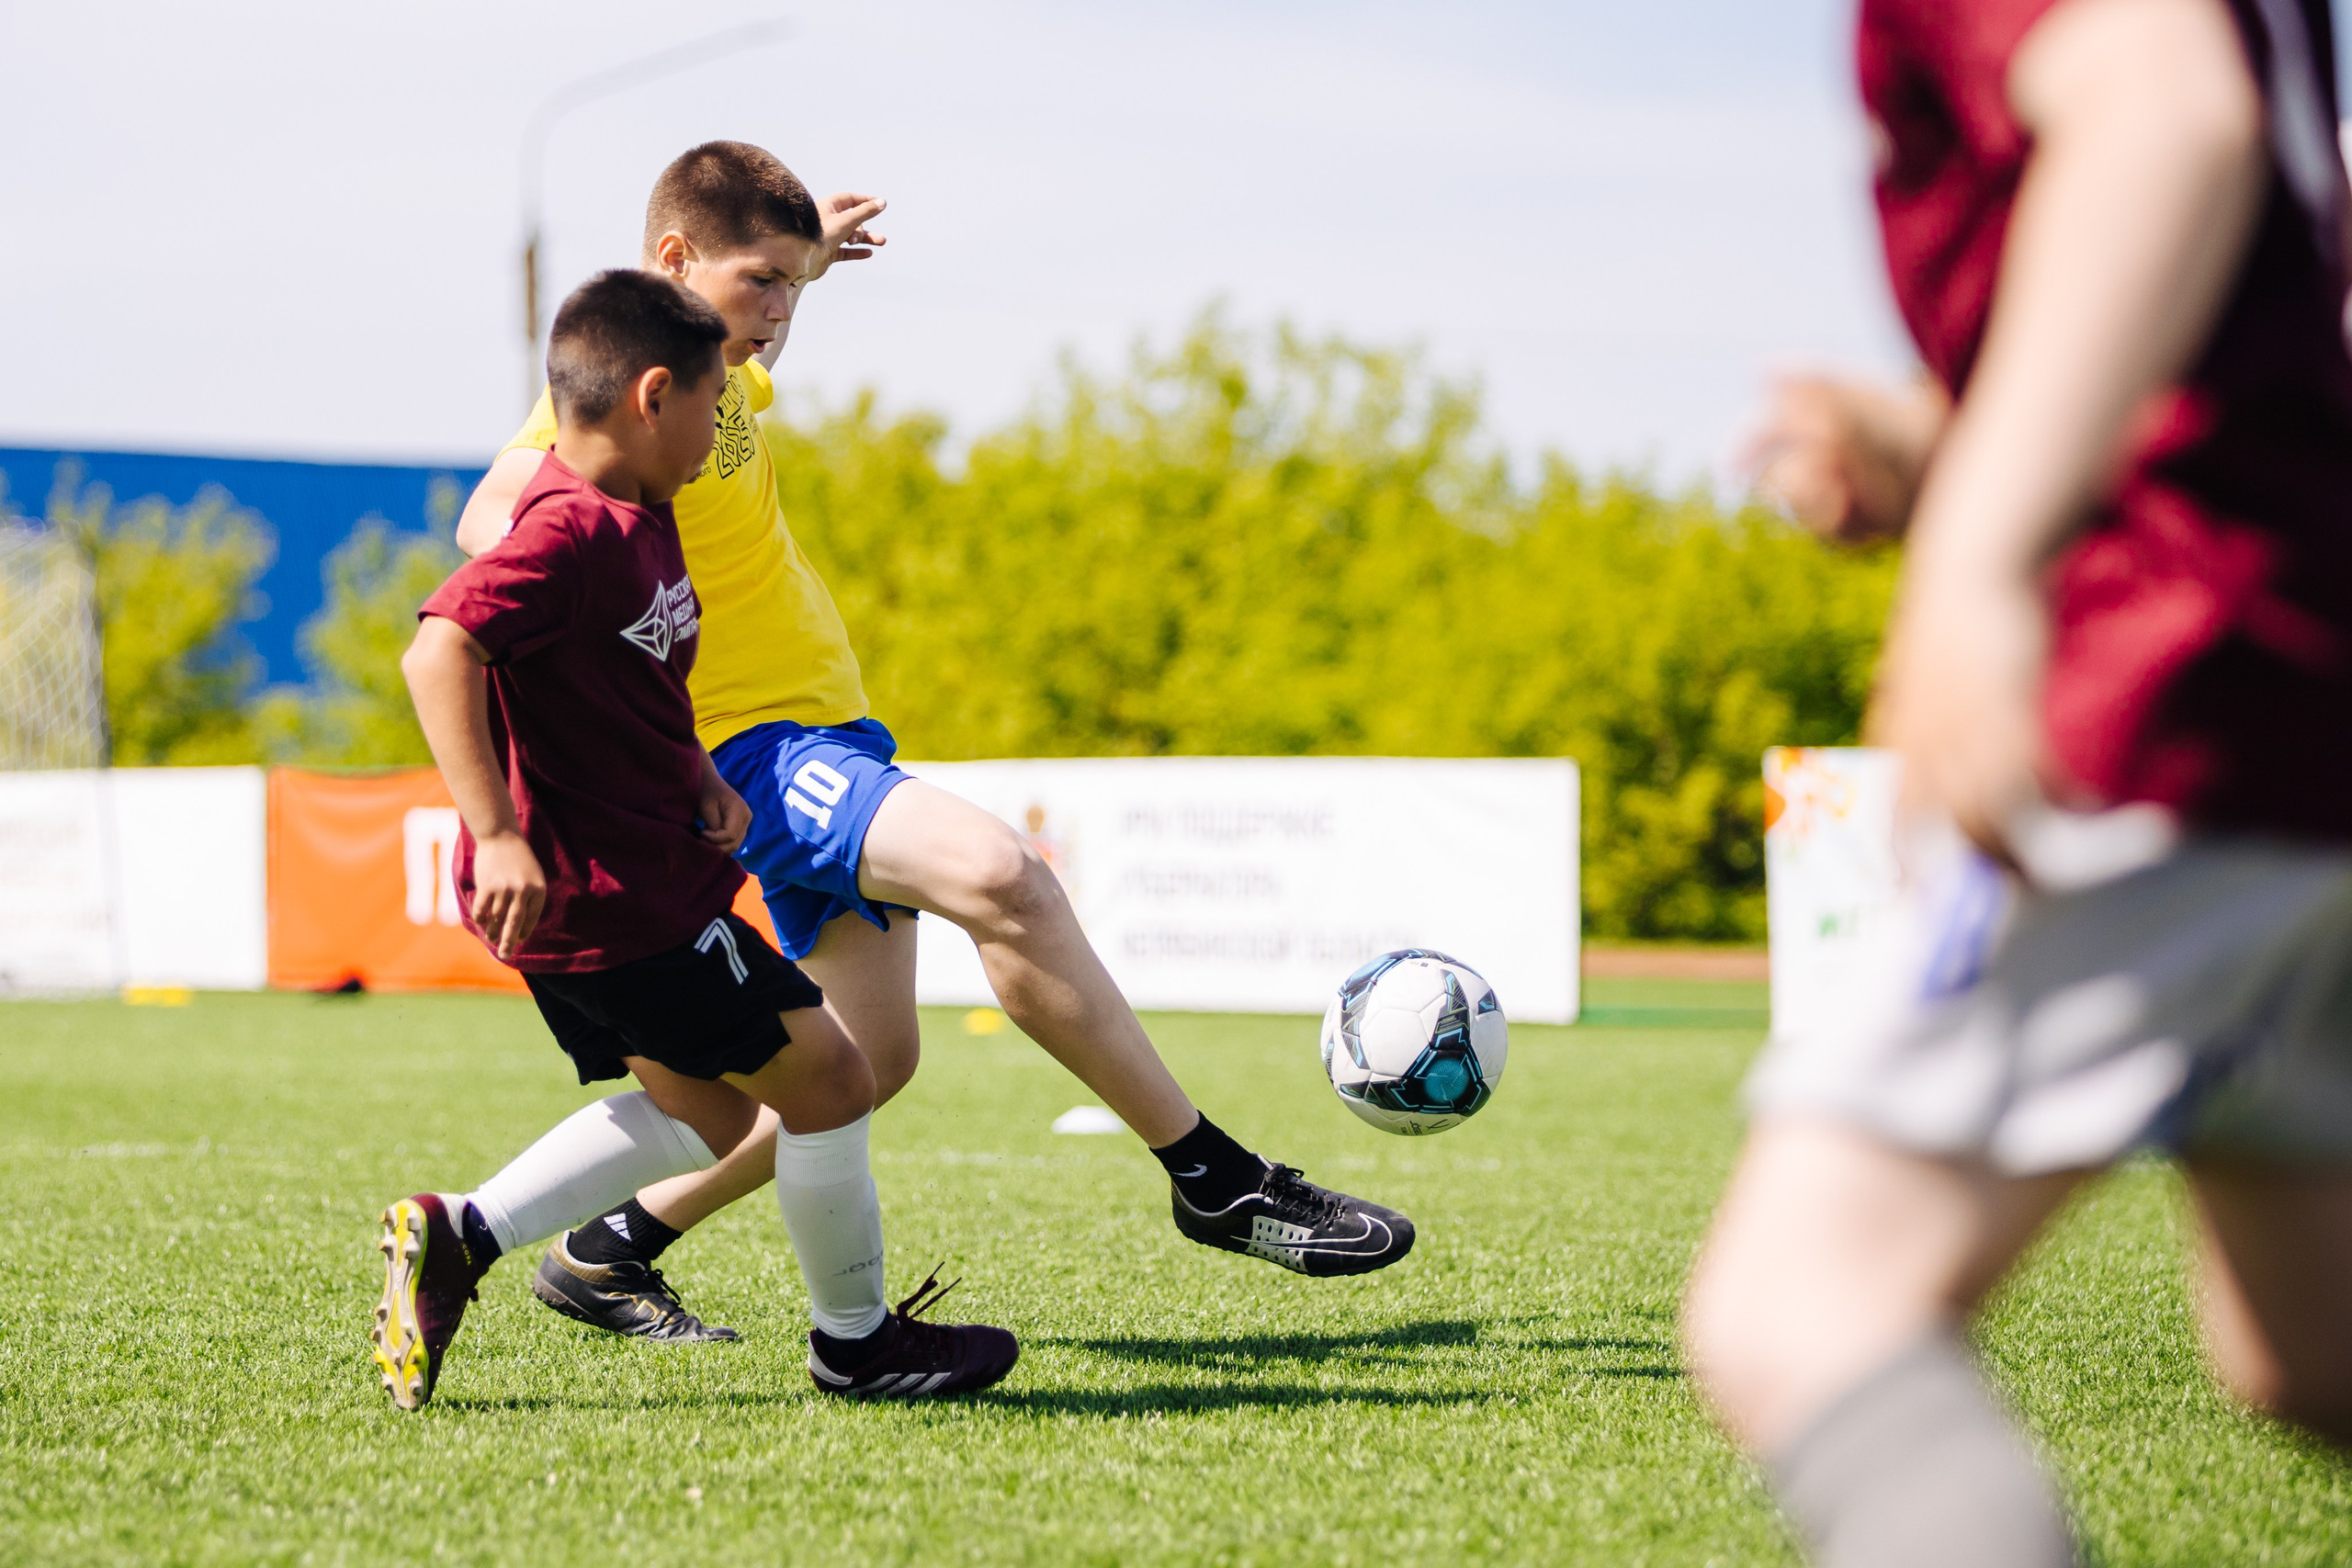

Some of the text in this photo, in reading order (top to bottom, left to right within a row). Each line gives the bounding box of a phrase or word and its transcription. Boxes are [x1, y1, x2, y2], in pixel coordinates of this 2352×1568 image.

[784, 760, 850, 830] 10
[694, 917, 749, 985] 7
[832, 1250, 884, 1277] JÖG
